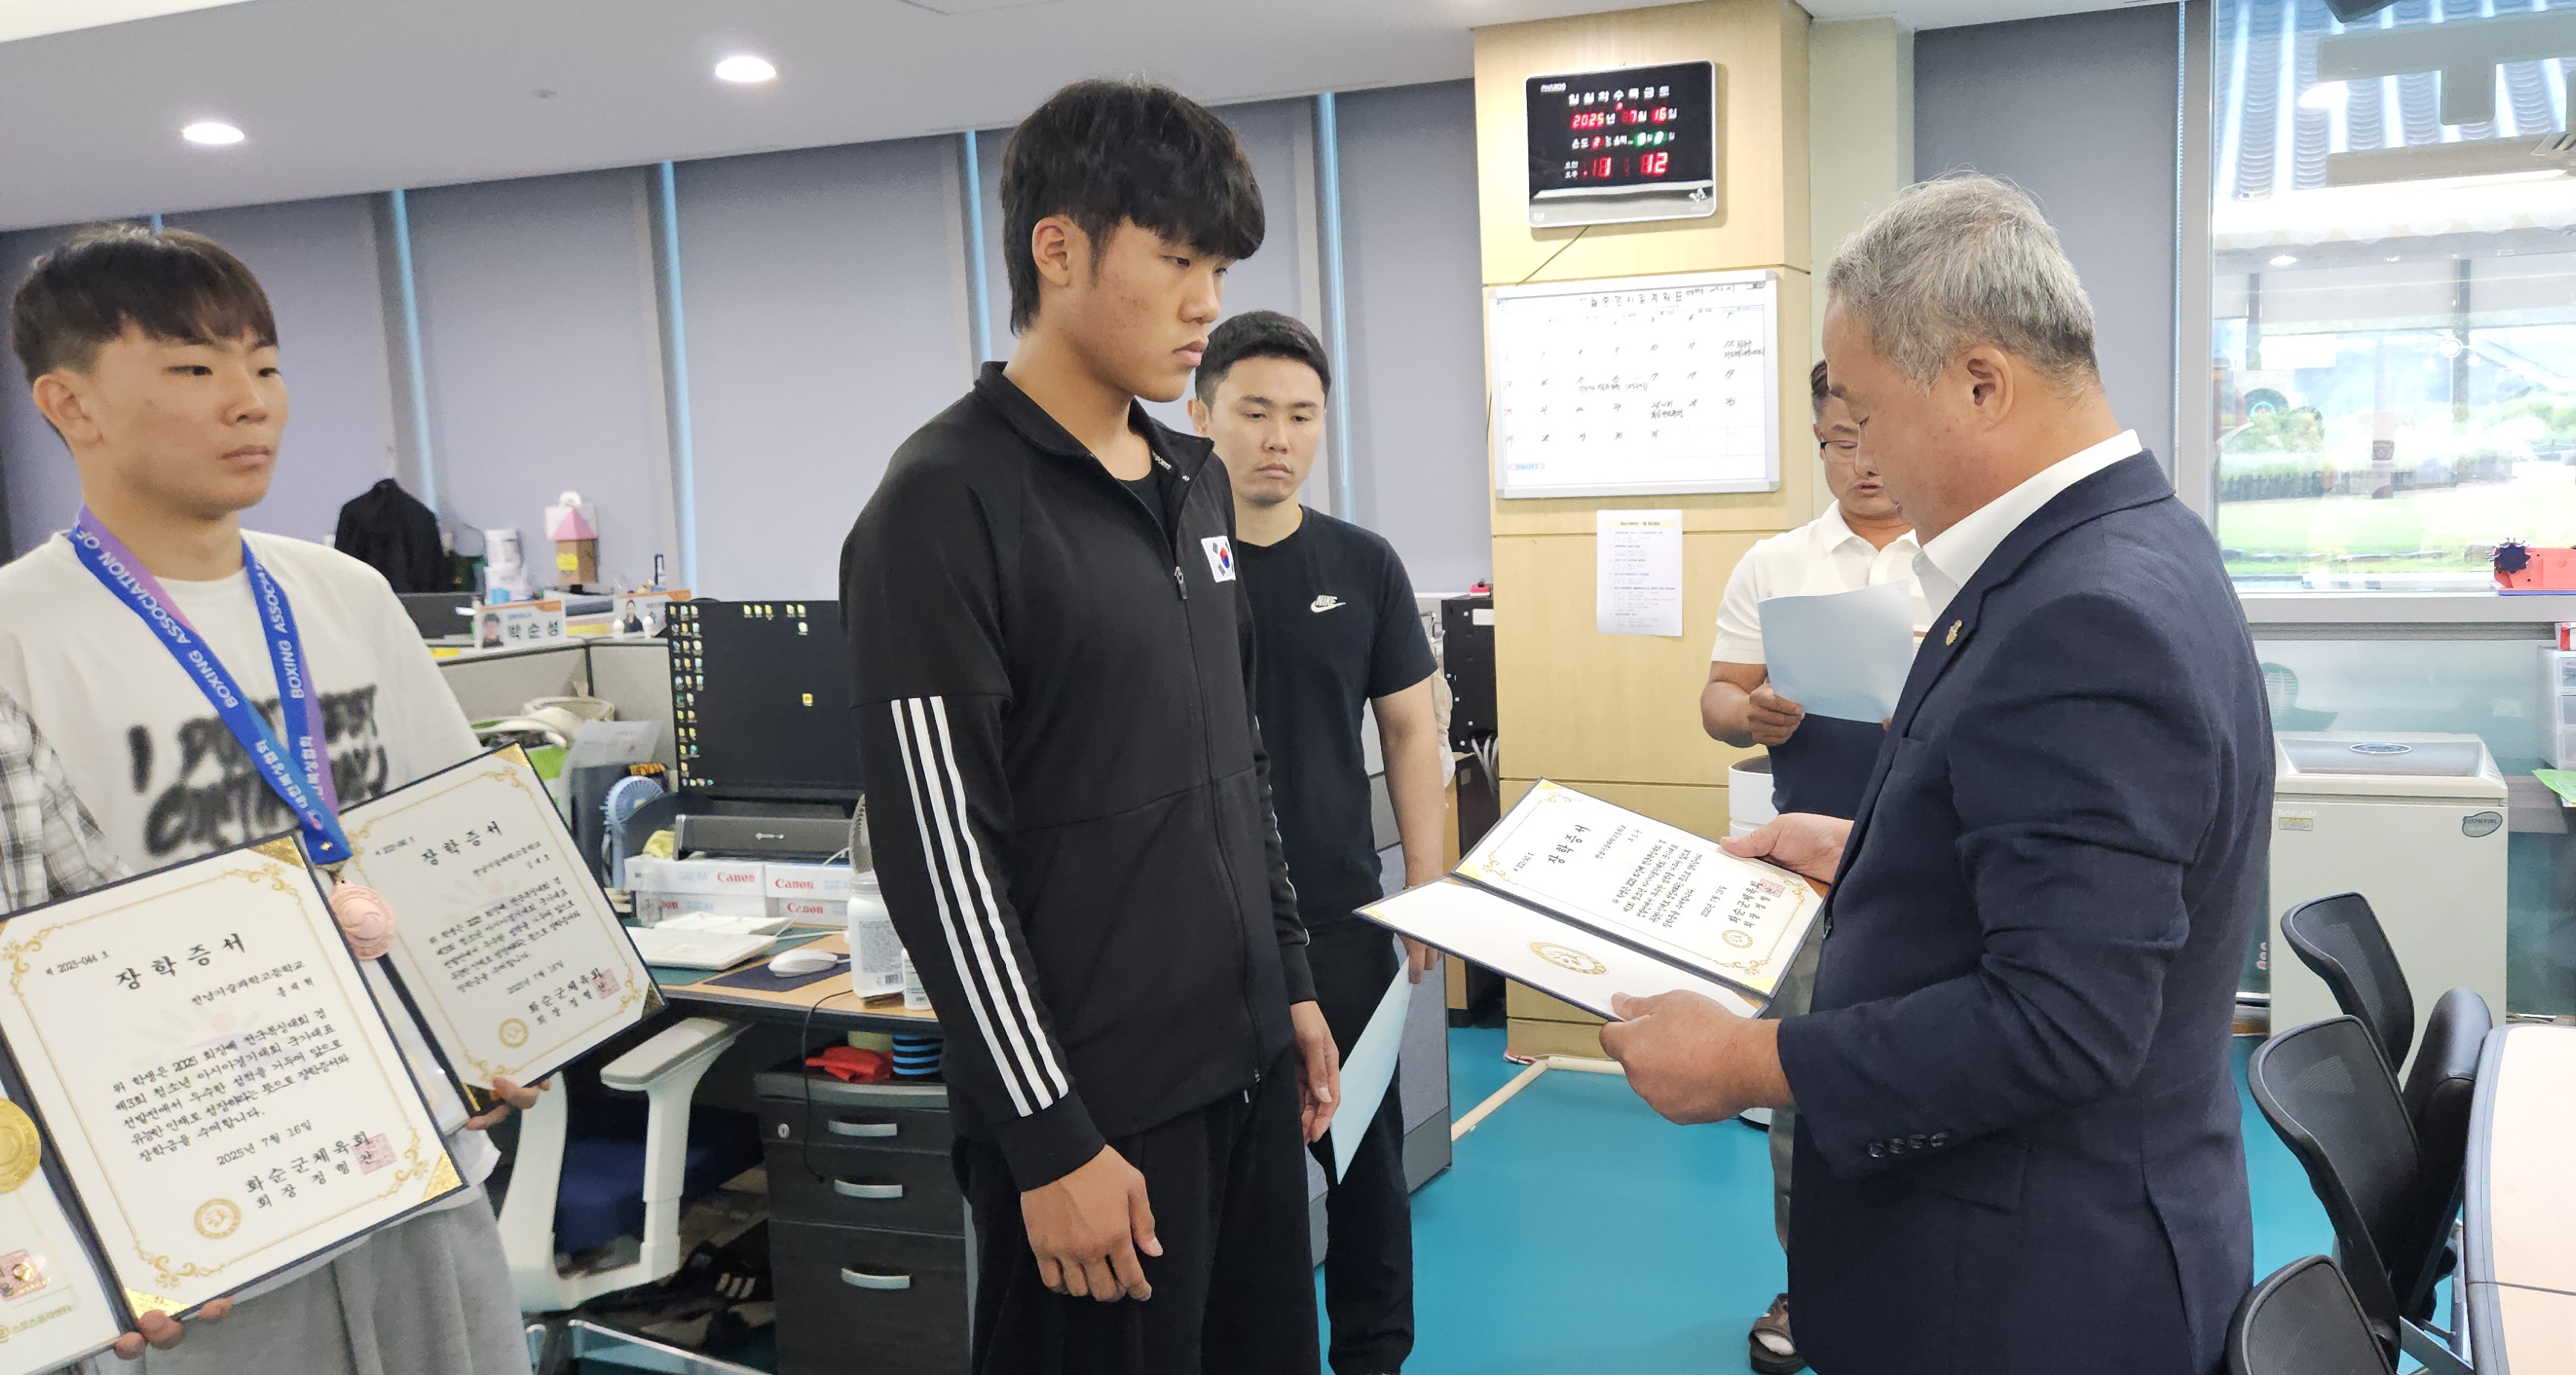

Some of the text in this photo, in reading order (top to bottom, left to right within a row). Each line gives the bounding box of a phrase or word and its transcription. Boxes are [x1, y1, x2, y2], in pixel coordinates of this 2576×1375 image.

[76, 531, 239, 708] BOXING ASSOCIATION OF
[1316, 594, 1338, 607] NIKE
[278, 640, 305, 699] BOXING
[1547, 824, 1592, 865] 장학증서
[717, 872, 755, 883] Canon
[775, 878, 815, 890] Canon
[787, 902, 824, 914] Canon
[115, 932, 246, 990] 장학증서
[131, 1065, 169, 1086] 학생은
[172, 1055, 199, 1073] 2025
[243, 1013, 310, 1046] 전국복싱대회
[153, 1075, 192, 1098] 청소년
[287, 1024, 336, 1047] 국가대표
[124, 1098, 183, 1129] 선발전에서
[189, 1082, 226, 1103] 우수한
[271, 1051, 307, 1071] 거두어
[310, 1039, 344, 1059] 앞으로
[131, 1125, 164, 1147] 유능한
[297, 1053, 350, 1081] 장학증서와
[138, 1106, 266, 1163] 장학금을 수여합니다.
[216, 1119, 313, 1167] 2025년 7월 16일
[245, 1131, 371, 1193] 화순군체육회
